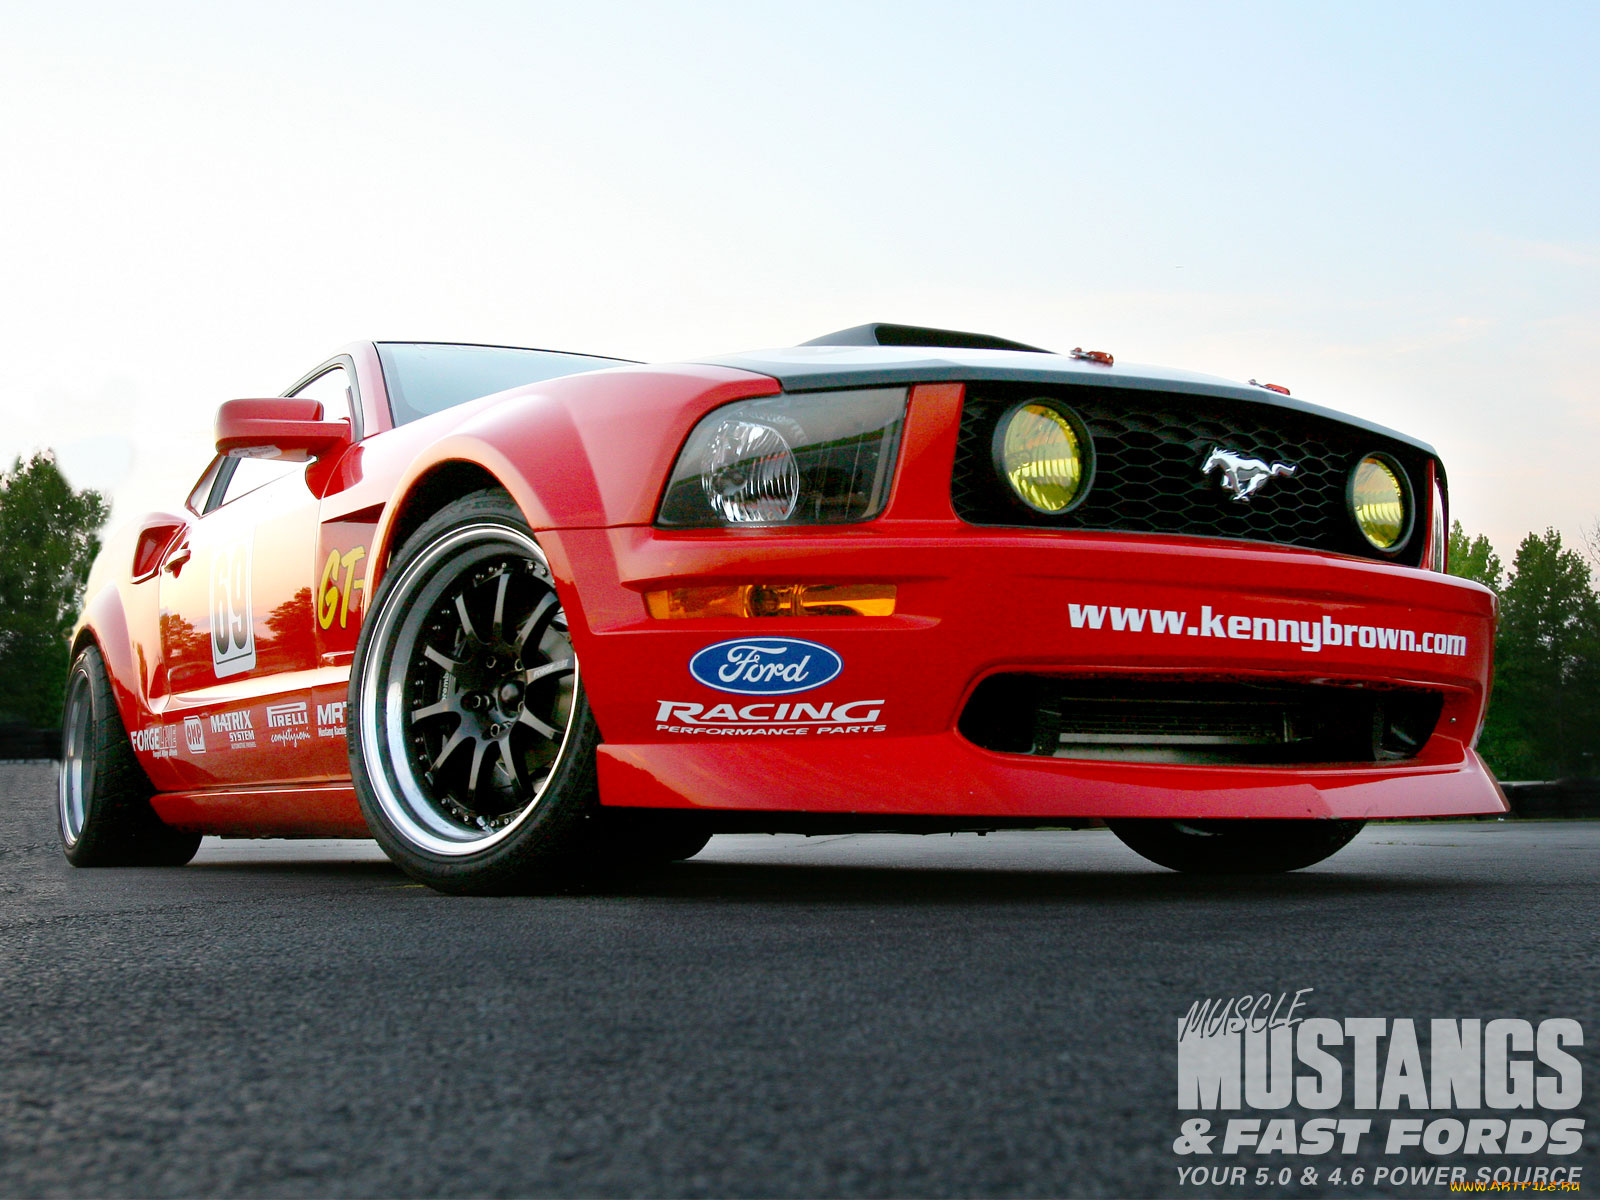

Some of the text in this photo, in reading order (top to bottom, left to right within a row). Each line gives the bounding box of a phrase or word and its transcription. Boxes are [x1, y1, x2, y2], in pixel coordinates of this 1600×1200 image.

[214, 544, 248, 655] 69
[1067, 602, 1467, 657] www.kennybrown.com
[718, 645, 811, 683] Ford
[210, 710, 253, 734] MATRIX
[266, 702, 309, 728] PIRELLI
[655, 699, 885, 725] RACING
[229, 730, 255, 742] SYSTEM
[656, 724, 887, 736] PERFORMANCE PARTS
